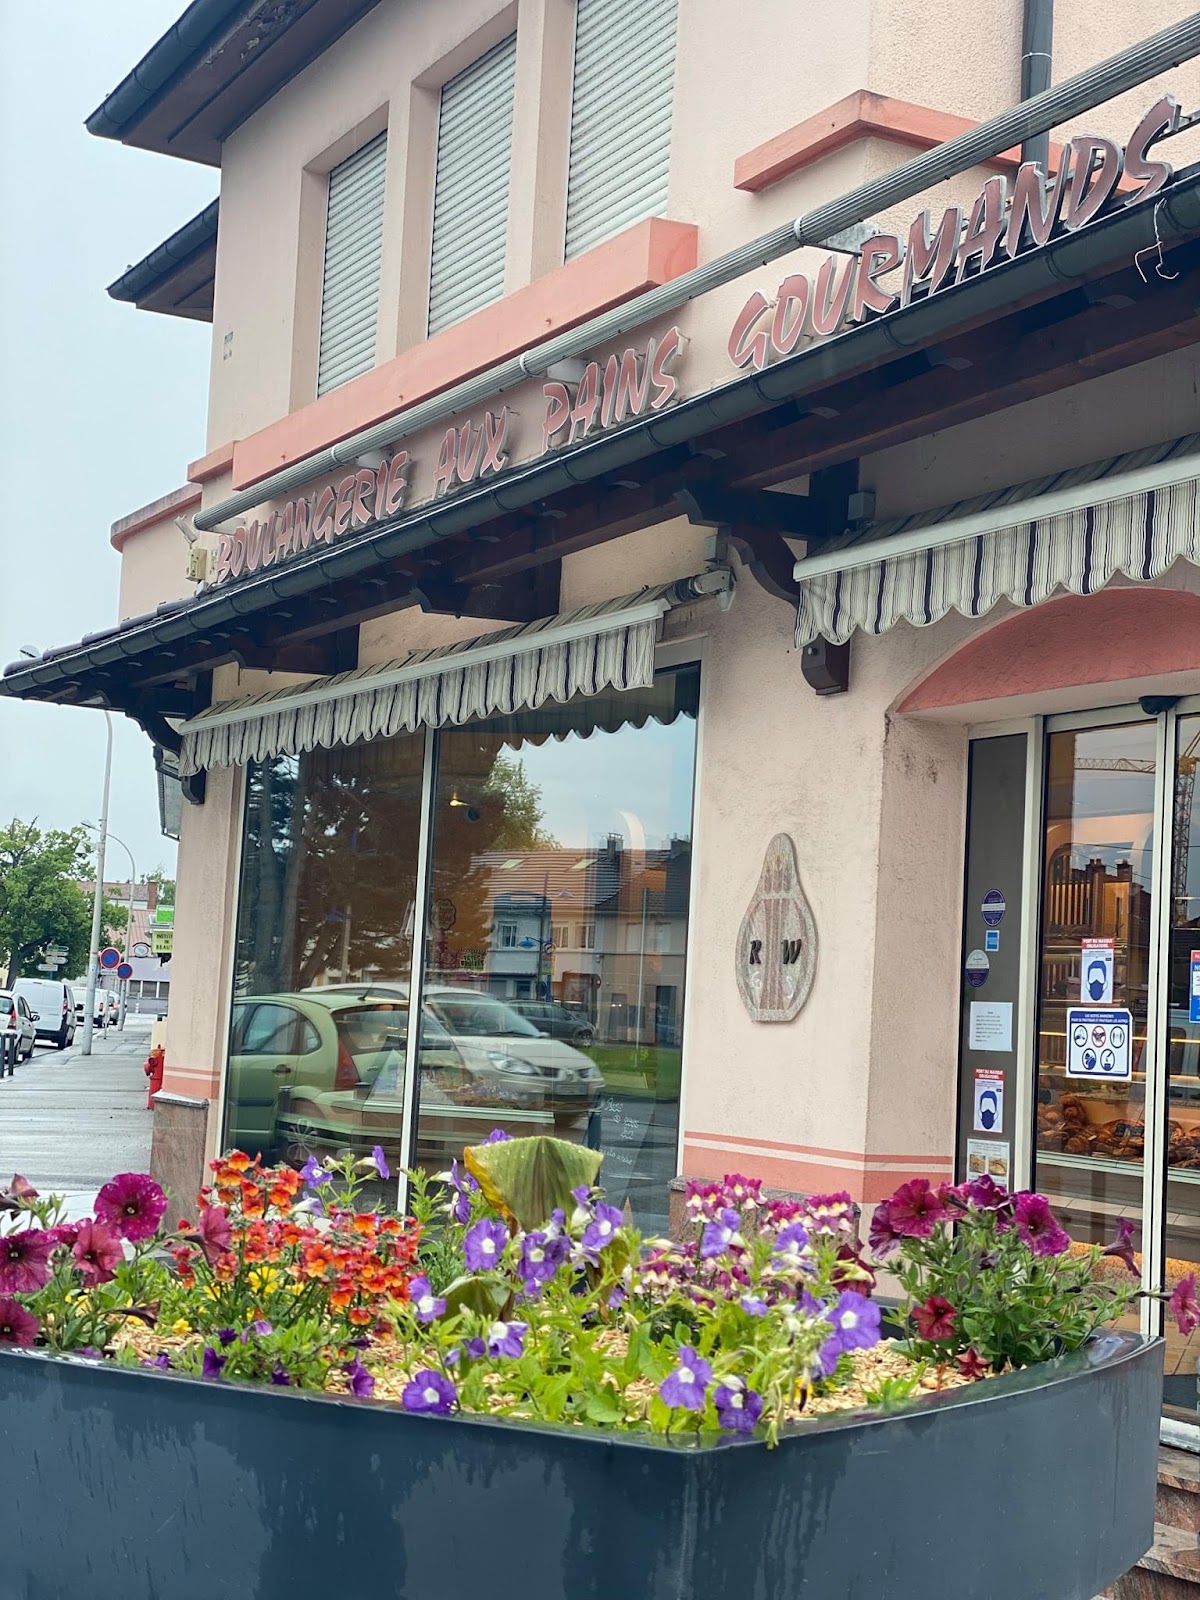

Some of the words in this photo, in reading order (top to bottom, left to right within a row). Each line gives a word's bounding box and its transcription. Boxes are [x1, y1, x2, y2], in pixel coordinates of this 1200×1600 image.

[216, 450, 412, 584] BOULANGERIE
[432, 405, 519, 499] AUX
[541, 326, 690, 454] PAINS
[727, 93, 1182, 371] GOURMANDS
[749, 939, 762, 965] R
[781, 939, 802, 965] W
